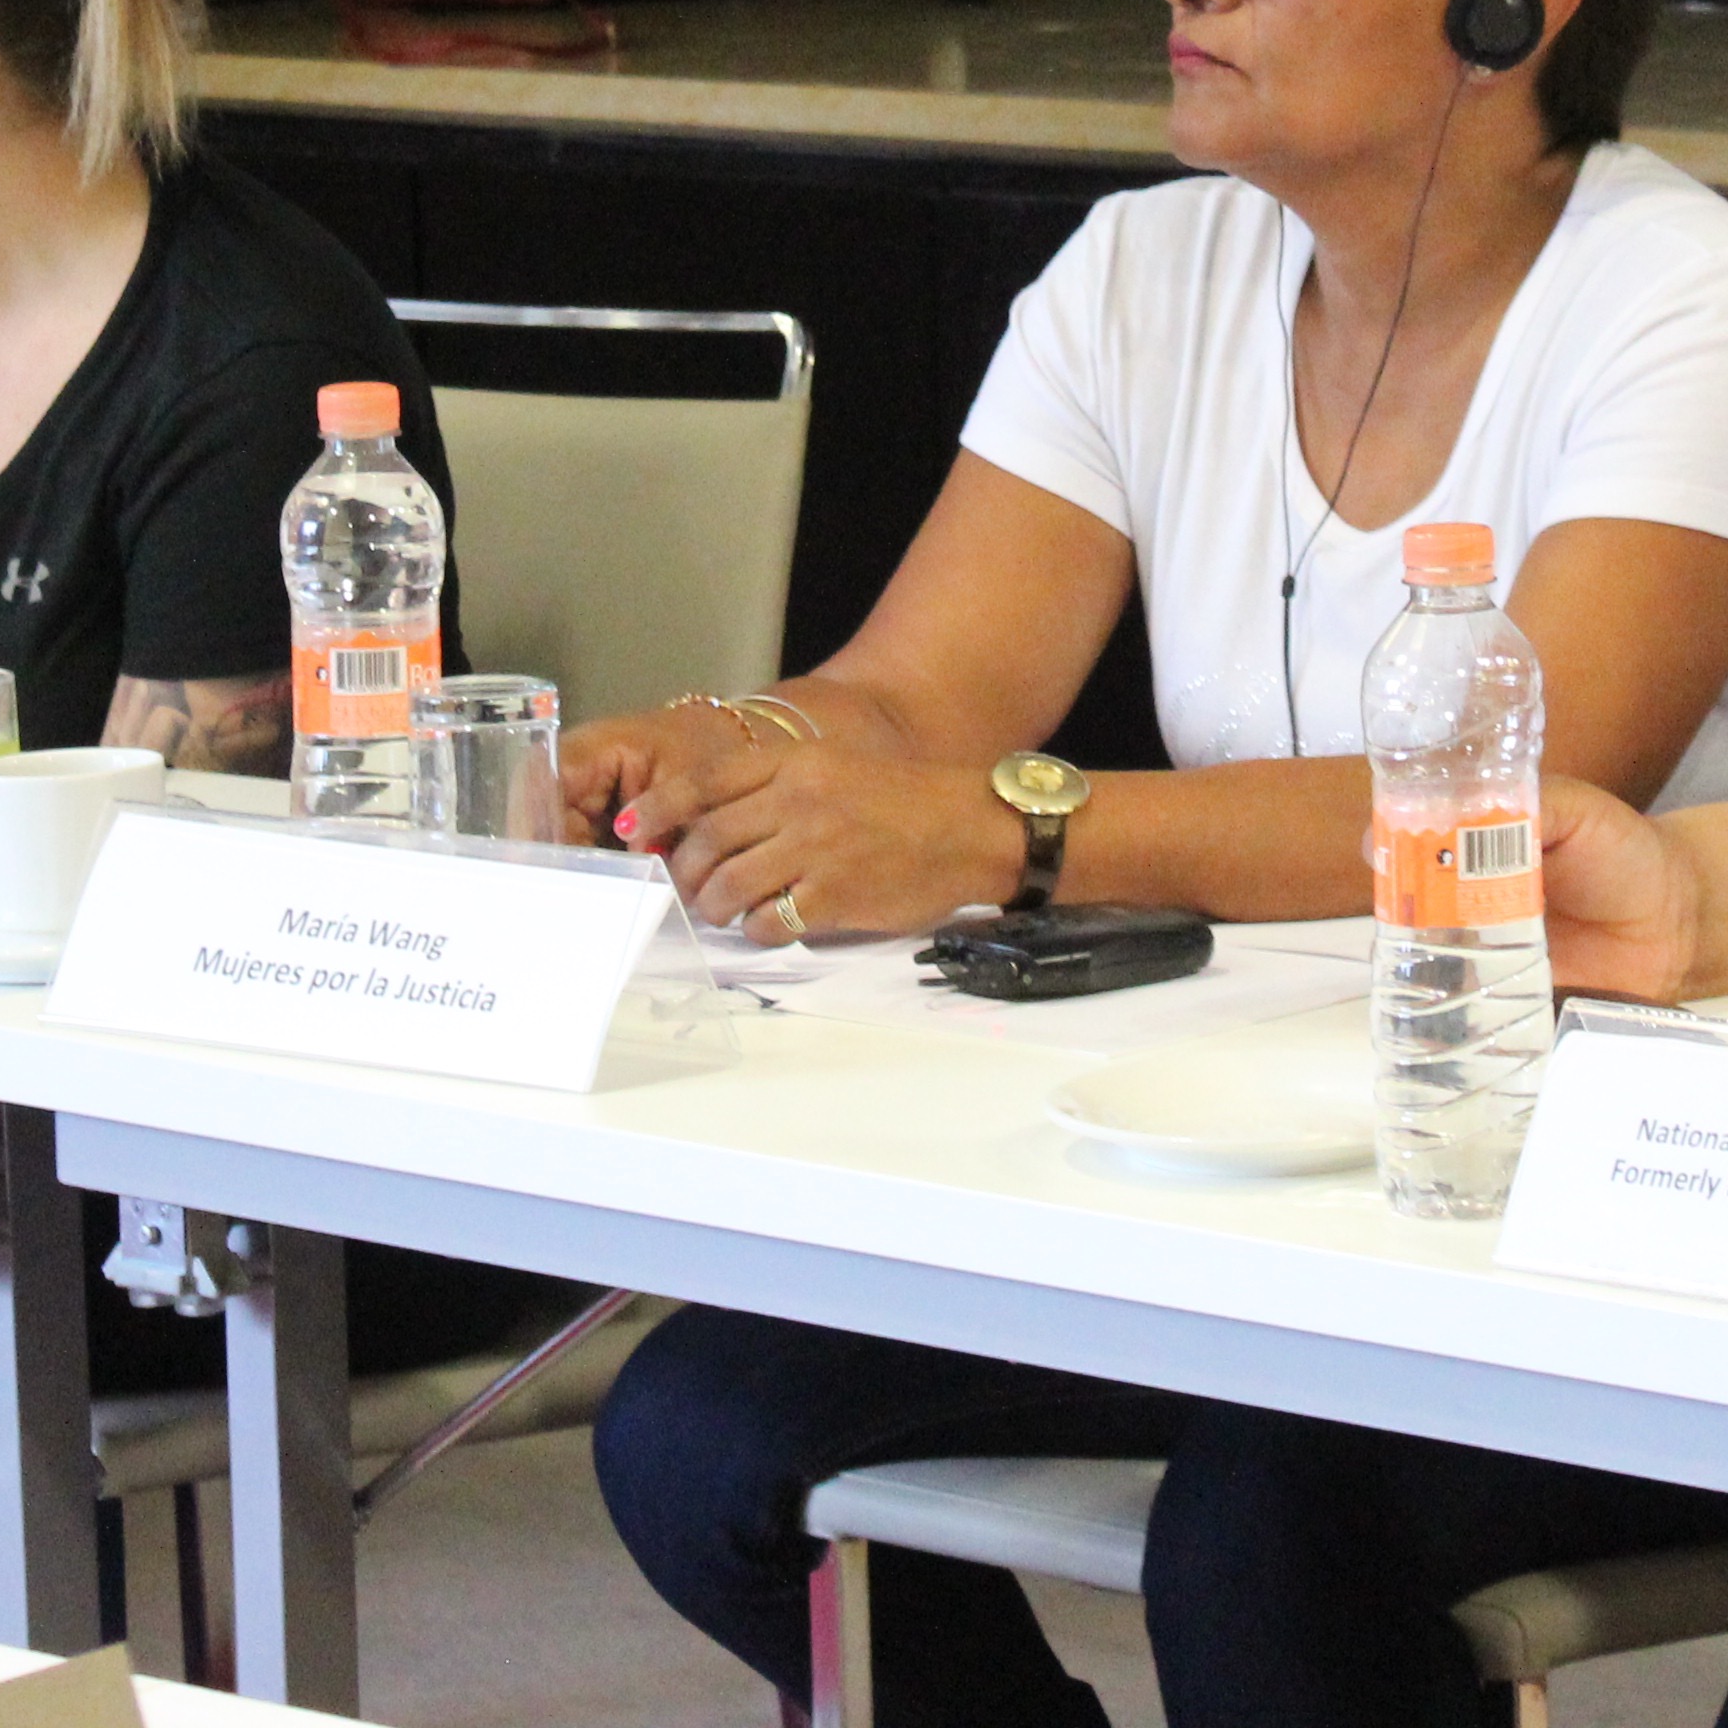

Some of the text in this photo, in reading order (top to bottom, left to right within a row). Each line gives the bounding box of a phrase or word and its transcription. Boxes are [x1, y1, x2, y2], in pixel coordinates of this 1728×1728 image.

[278, 907, 447, 961] María Wang
[192, 946, 497, 1014] Mujeres por la Justicia
[1609, 1158, 1722, 1200] Formerly
